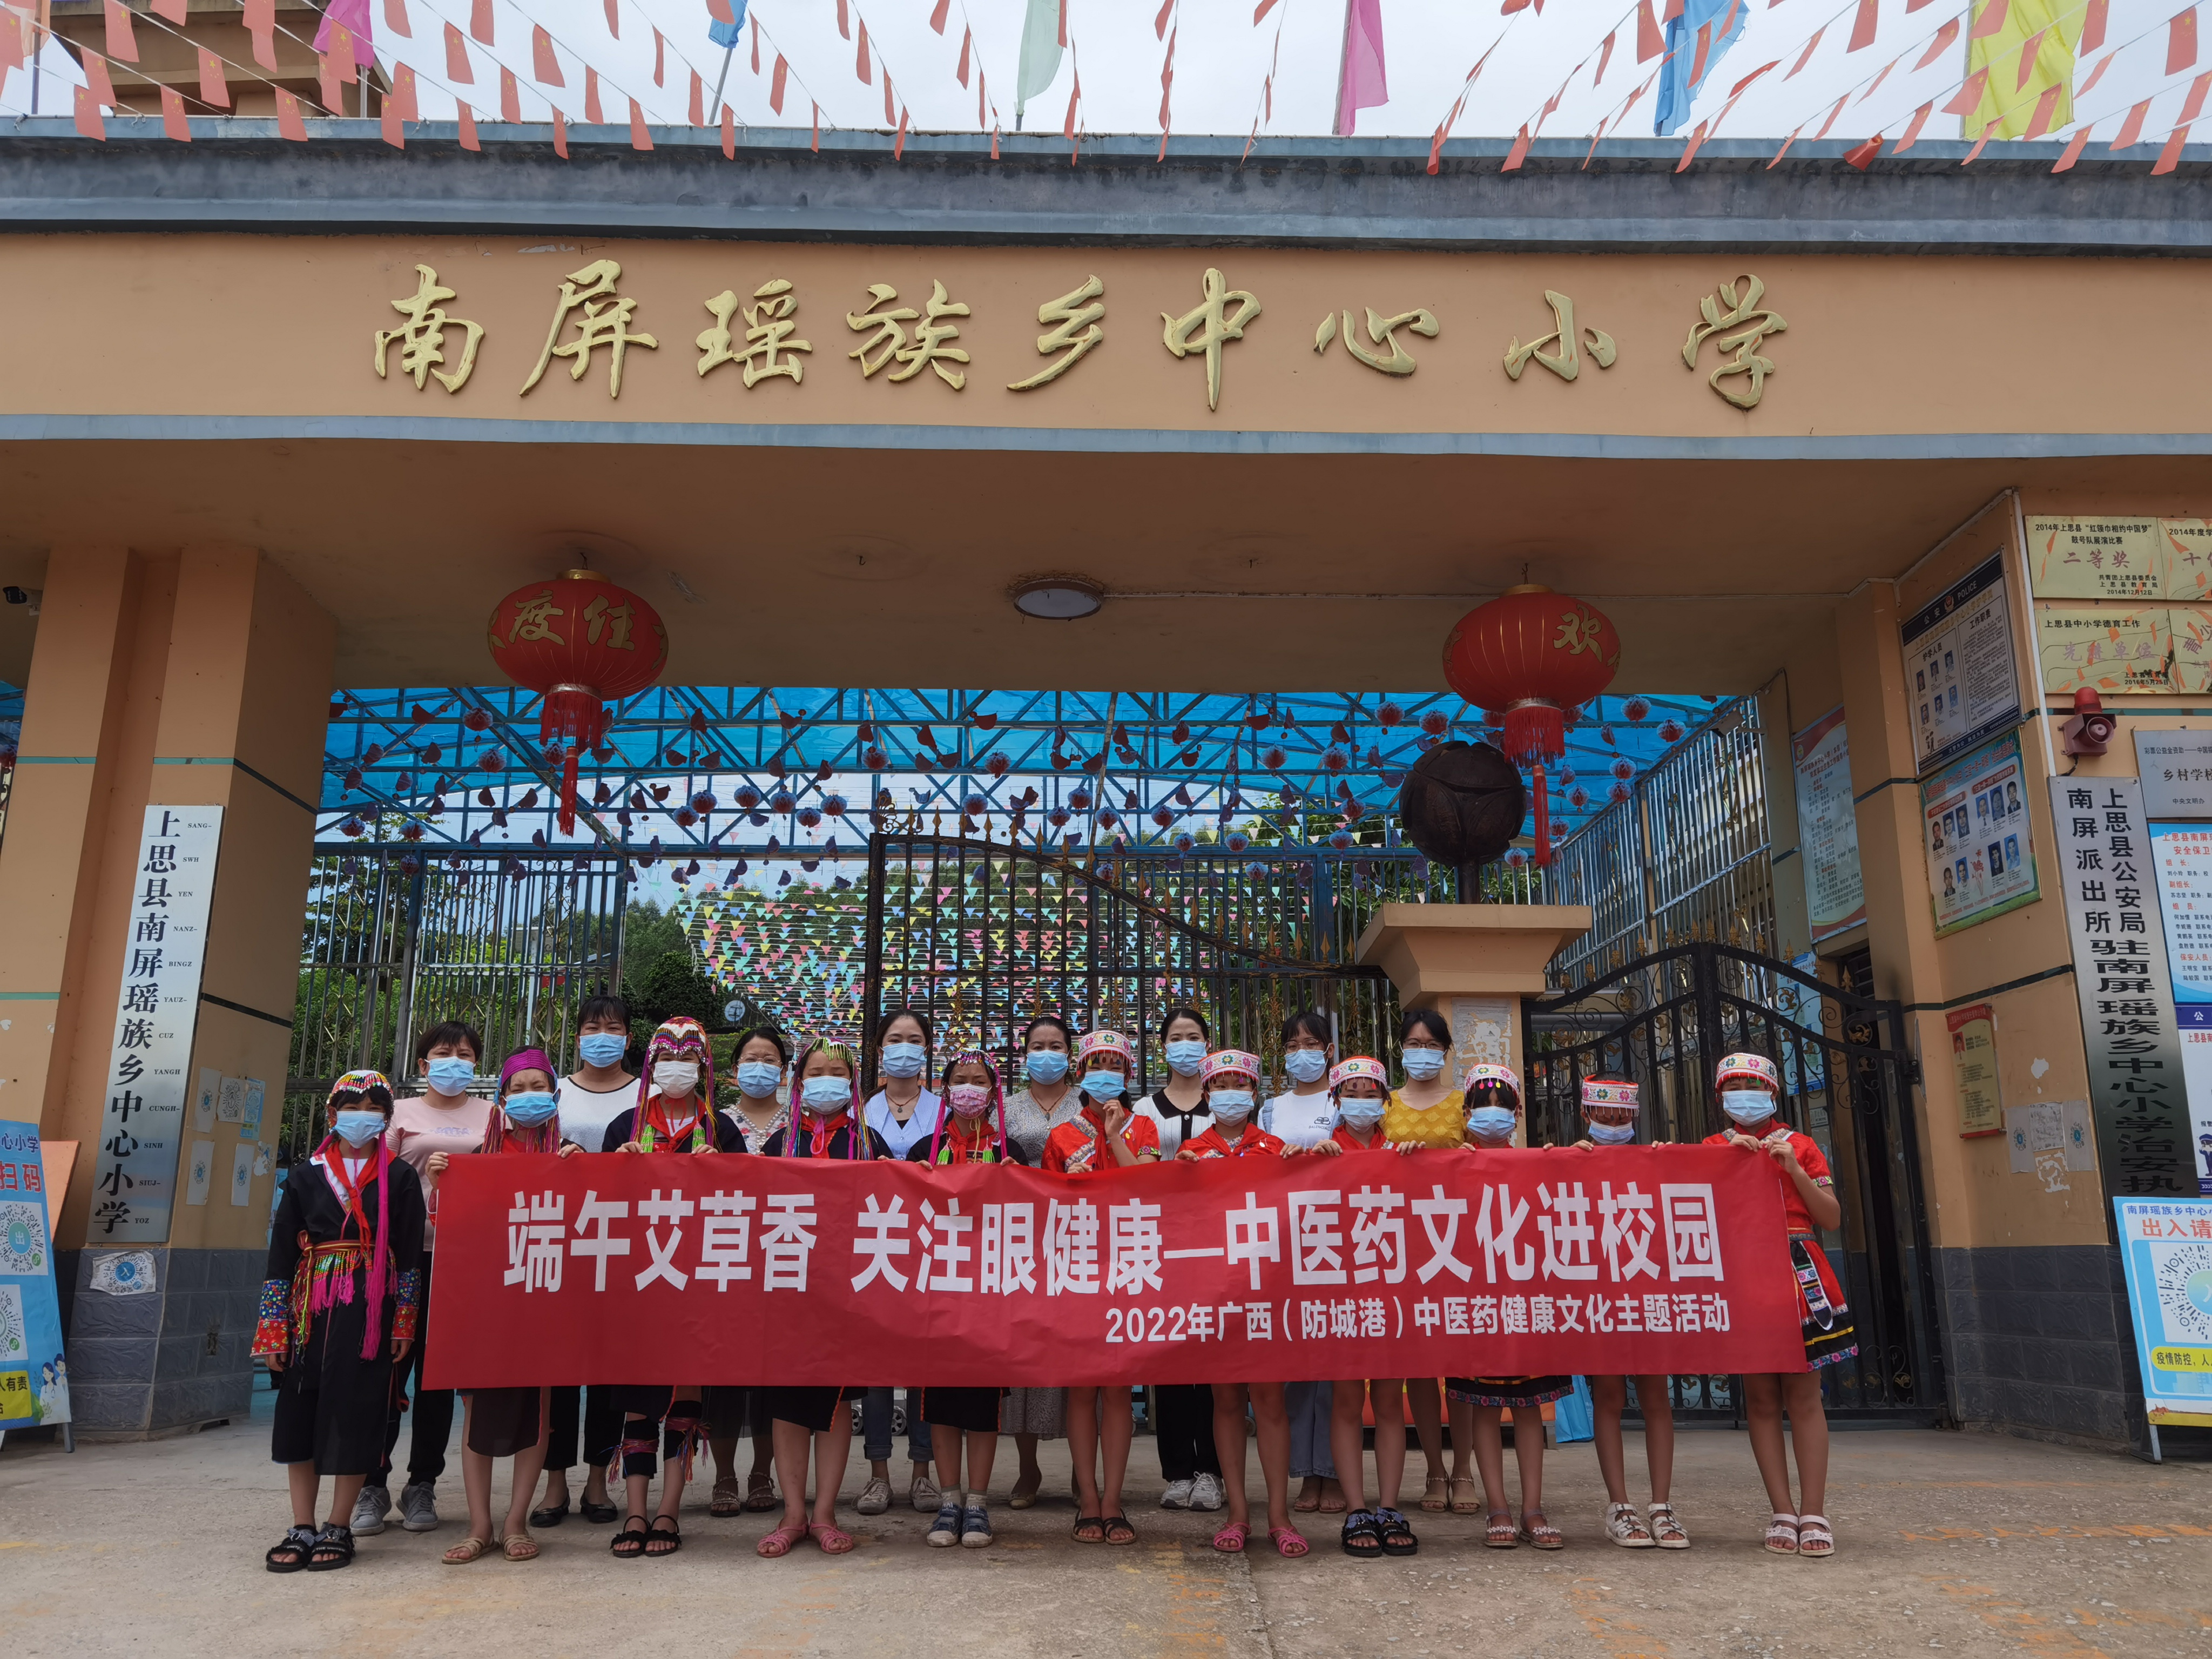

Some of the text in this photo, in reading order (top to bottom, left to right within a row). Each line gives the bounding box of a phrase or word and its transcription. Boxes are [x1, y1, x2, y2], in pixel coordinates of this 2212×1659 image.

[374, 259, 1788, 412] 南屏瑶族乡中心小学
[2072, 536, 2123, 545] 鼓号队展演比赛
[2063, 549, 2130, 569] 二等奖
[1957, 580, 1977, 601] POLICE
[1924, 607, 1940, 625] 公安
[1970, 609, 1991, 629] 工作职责
[2045, 619, 2140, 628] 上思县中小学德育工作
[1553, 603, 1602, 662] 欢
[1923, 642, 1943, 662] 护学人员
[2067, 788, 2111, 934] 南屏派出所
[2102, 788, 2146, 934] 上思县公安局
[93, 811, 180, 1234] 上思县南屏瑶族乡中心小学
[2188, 1033, 2212, 1043] 上思县南
[1, 1133, 38, 1152] 心小学
[2127, 1205, 2212, 1216] 南屏瑶族乡中心
[504, 1188, 818, 1293] 端午艾草香
[2156, 1352, 2212, 1366] 疫情防控，人
